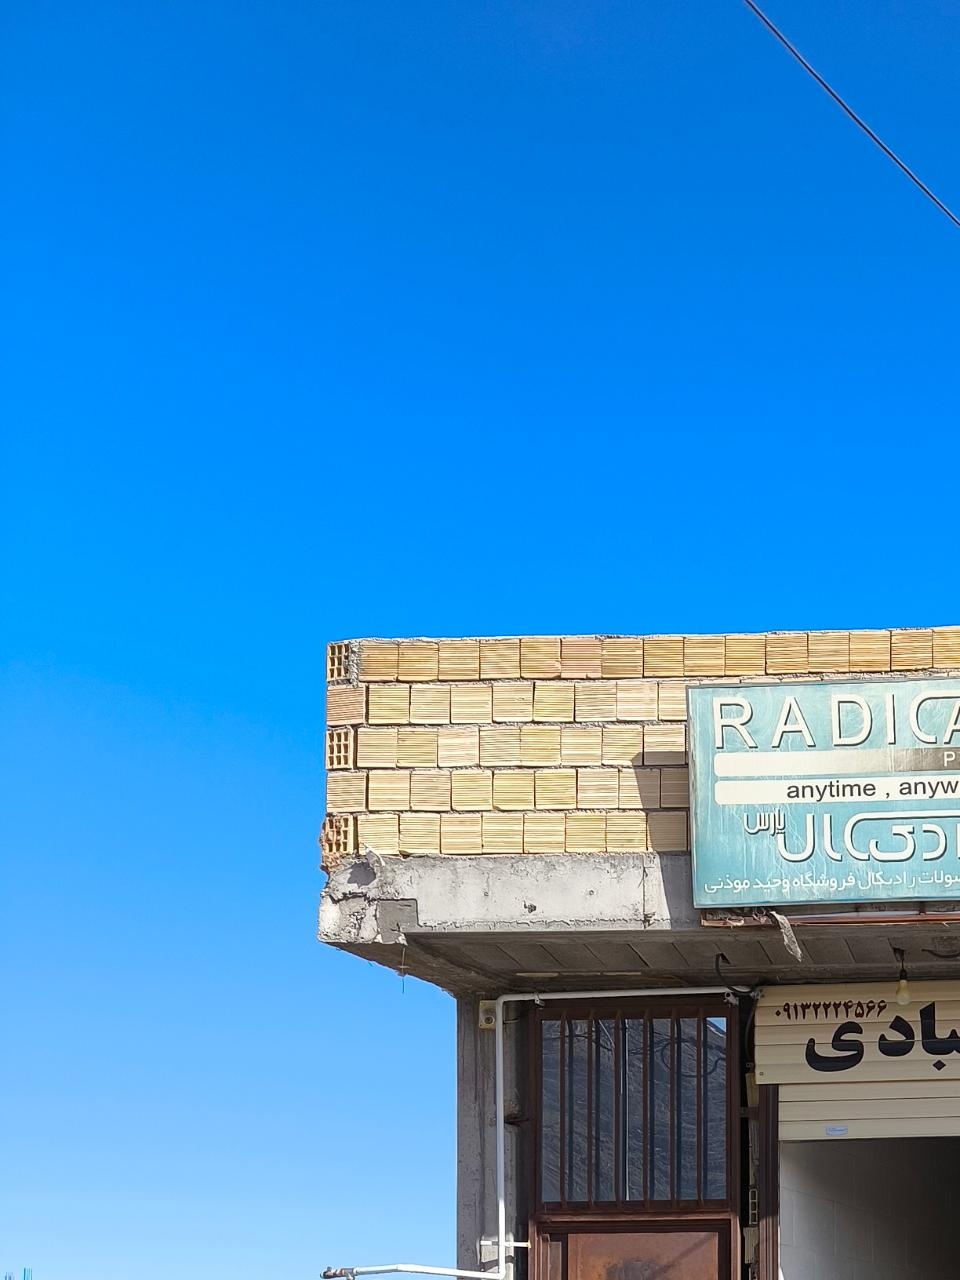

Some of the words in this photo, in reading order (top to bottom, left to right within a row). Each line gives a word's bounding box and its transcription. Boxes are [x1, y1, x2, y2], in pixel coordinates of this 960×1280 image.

[786, 779, 877, 803] anytime
[752, 875, 791, 893] وحید
[792, 872, 856, 891] فروشگاه
